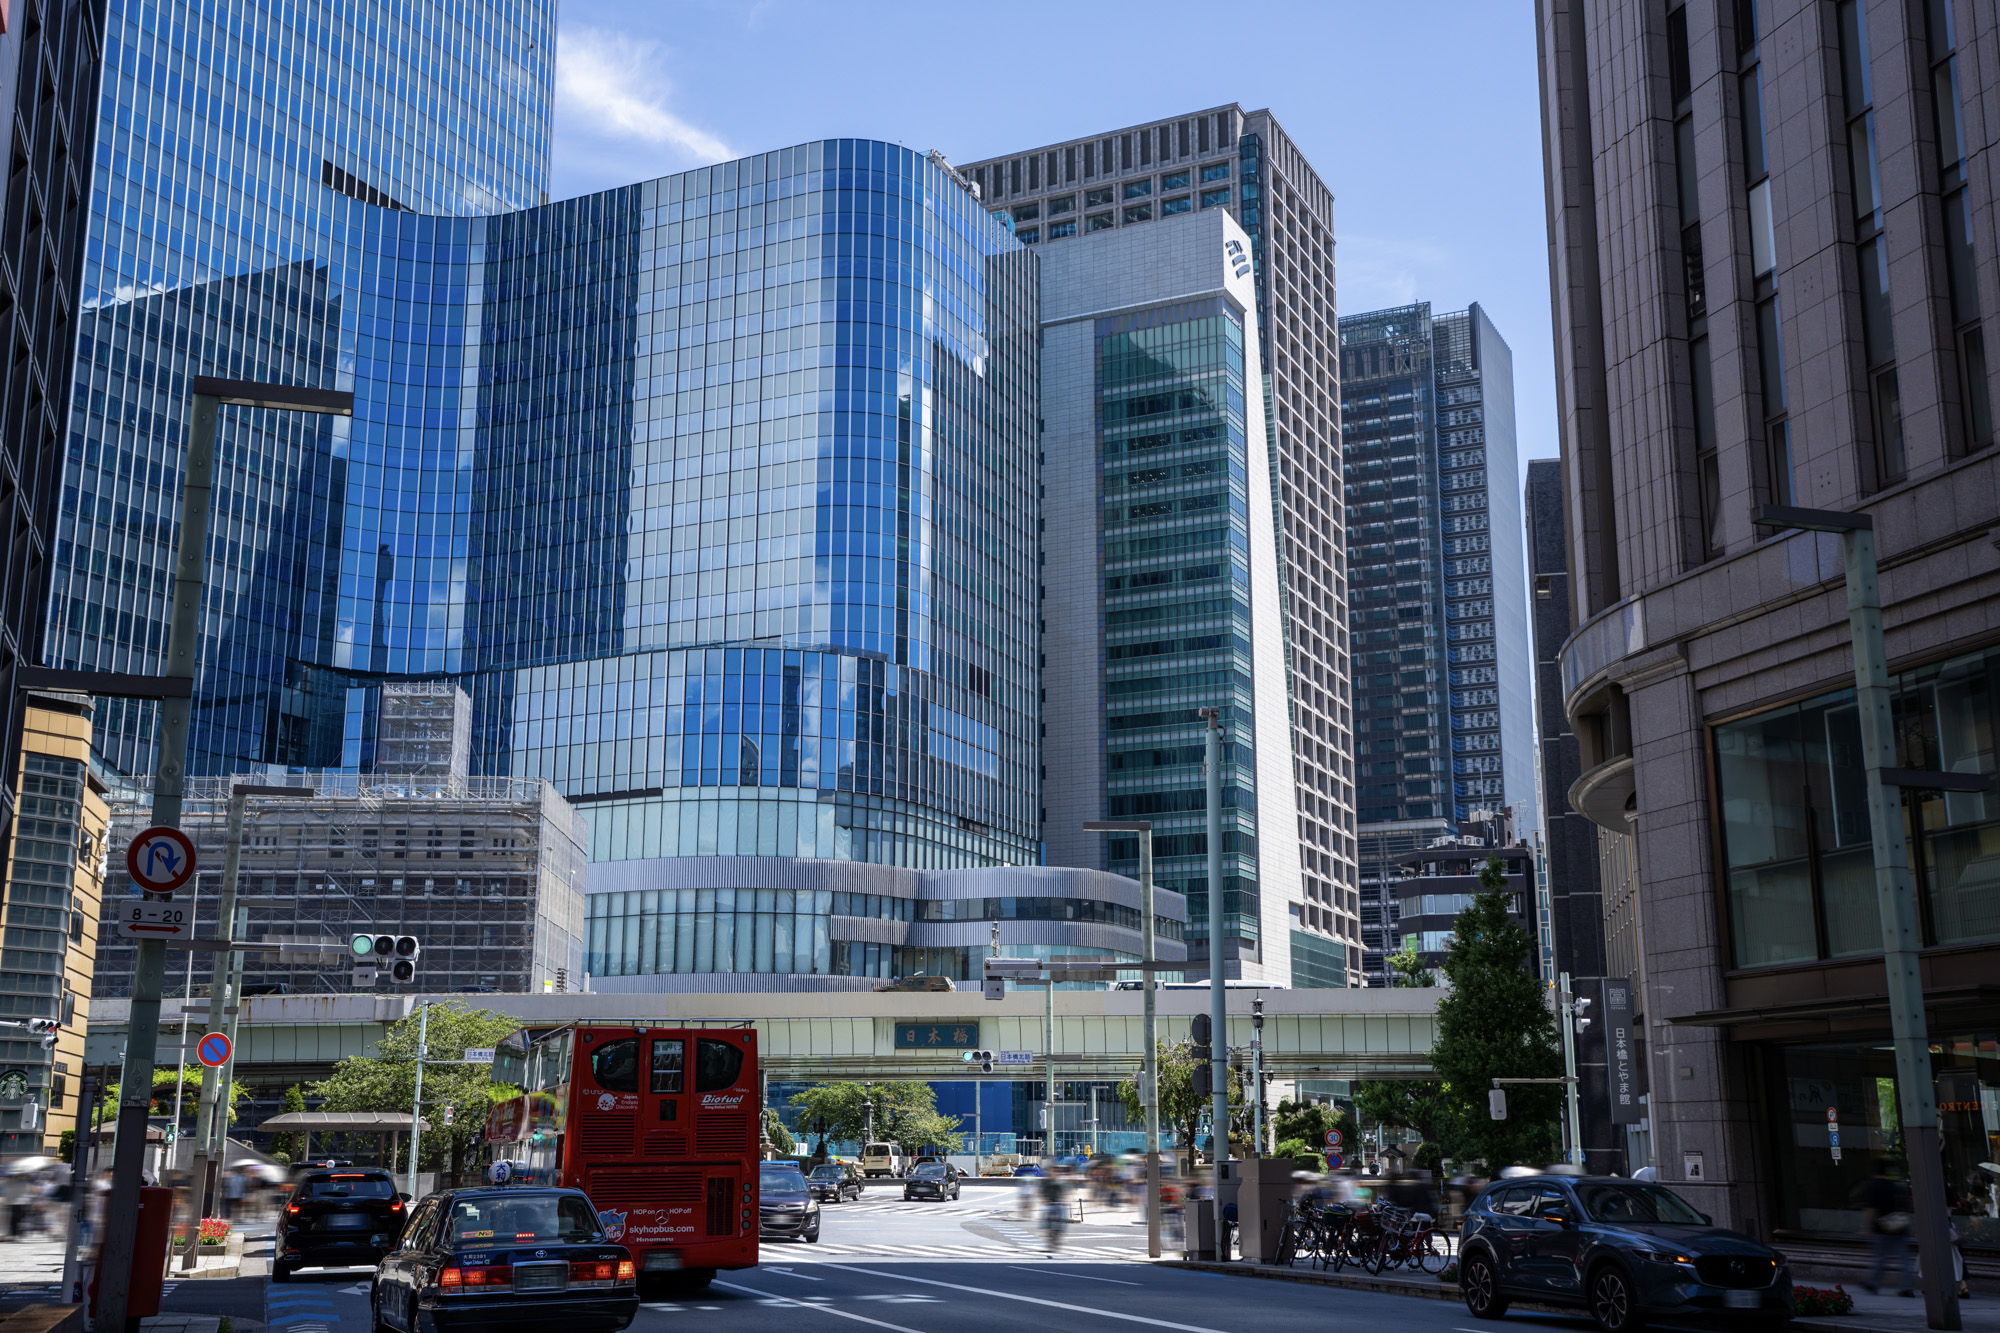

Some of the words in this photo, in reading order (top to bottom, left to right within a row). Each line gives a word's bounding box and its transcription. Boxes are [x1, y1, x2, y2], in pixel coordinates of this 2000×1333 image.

[906, 1027, 969, 1044] 日本橋
[1615, 1028, 1631, 1105] 日本橋とやま館
[702, 1095, 744, 1103] Biofuel
[1328, 1134, 1339, 1143] 30
[605, 1225, 617, 1233] OP
[629, 1225, 695, 1235] skyhopbus.com
